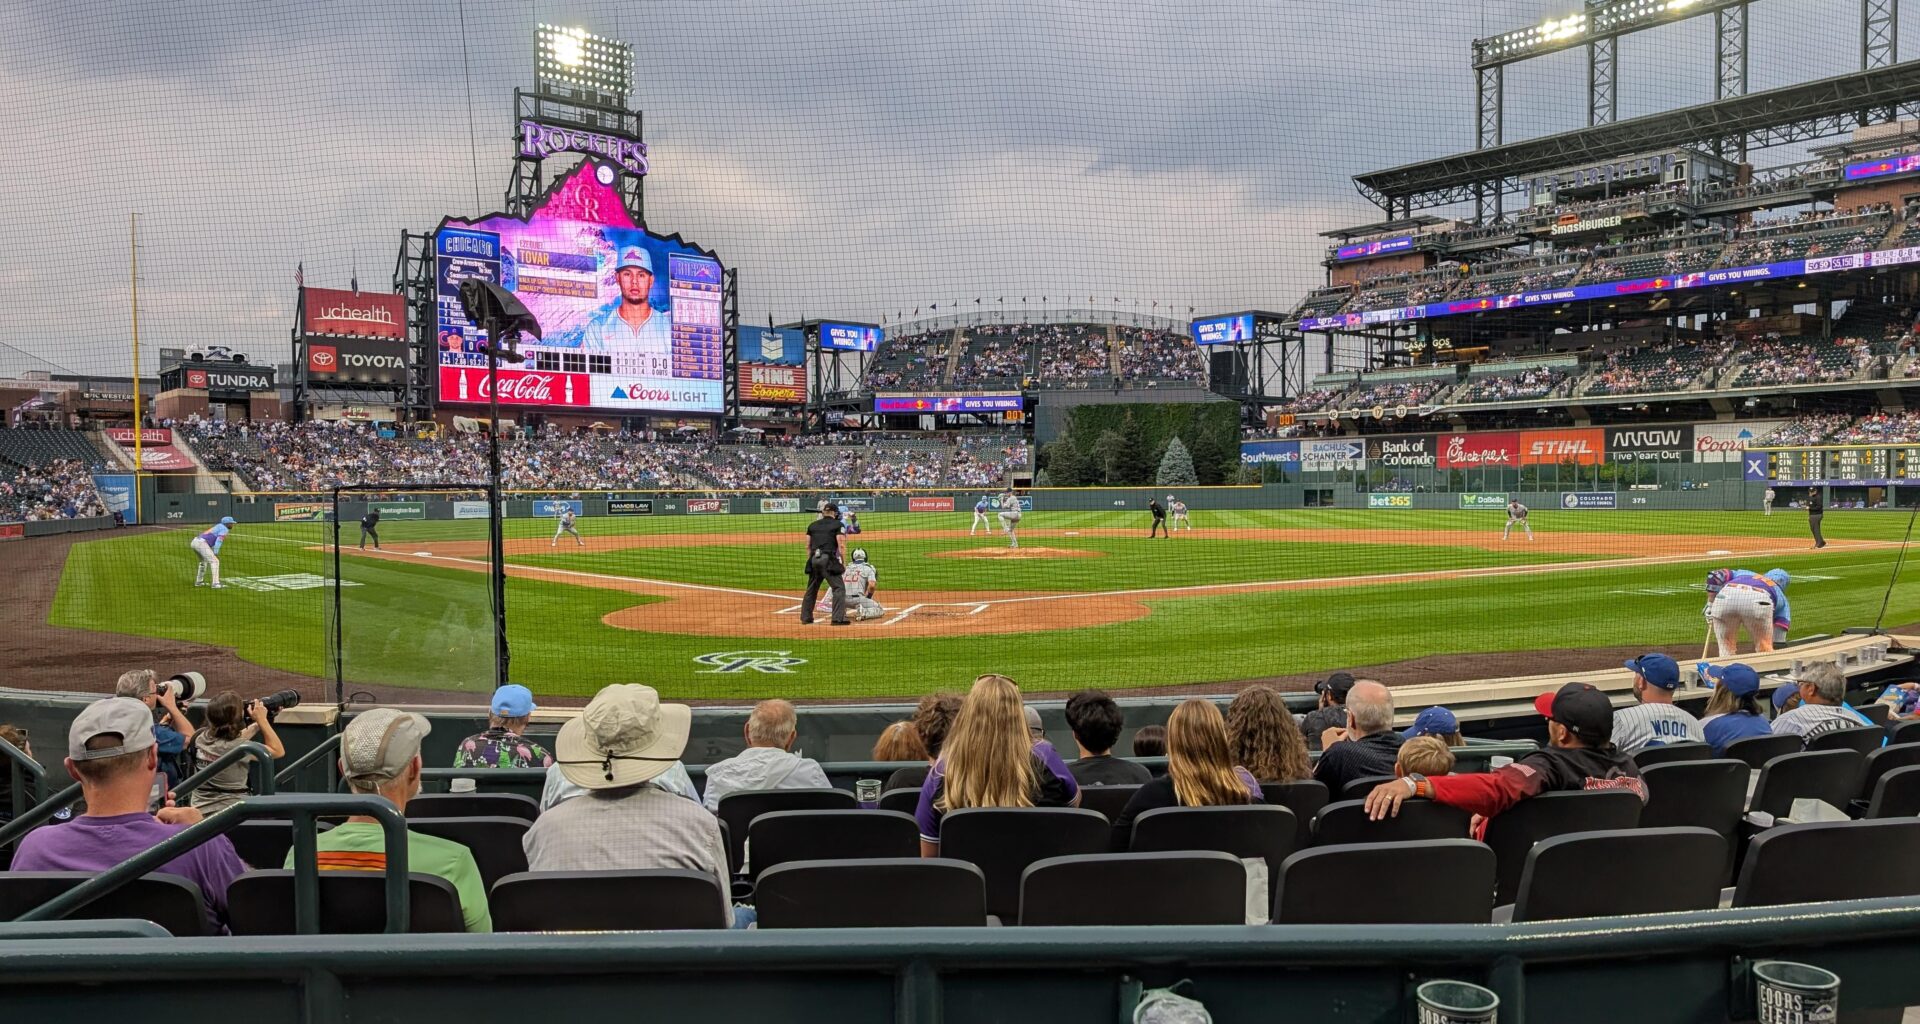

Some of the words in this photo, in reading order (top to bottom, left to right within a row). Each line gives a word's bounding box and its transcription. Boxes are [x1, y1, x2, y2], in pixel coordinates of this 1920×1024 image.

[521, 120, 649, 174] ROCKIES
[446, 237, 493, 257] CHICAGO
[519, 250, 550, 266] TOVAR
[1708, 273, 1727, 282] GIVES
[1728, 271, 1742, 280] YOU
[1525, 294, 1539, 302] GIVES
[1540, 293, 1552, 301] YOU
[321, 302, 392, 323] uchealth
[830, 328, 846, 337] GIVES
[847, 330, 858, 338] YOU
[1199, 323, 1214, 333] GIVES
[1214, 322, 1227, 331] YOU
[468, 342, 474, 351] 0
[342, 353, 405, 369] TOYOTA
[207, 374, 269, 388] TUNDRA
[752, 367, 795, 386] KING
[629, 383, 671, 401] Coors
[671, 391, 708, 403] LIGHT
[751, 383, 797, 399] Soopers
[827, 411, 844, 420] PLATTE
[1375, 408, 1381, 416] 17
[1382, 441, 1410, 453] Bank
[1412, 438, 1425, 452] of
[1613, 430, 1681, 447] ARROW
[1697, 435, 1744, 452] Coors
[1312, 442, 1347, 452] BACHUS
[1529, 440, 1593, 455] STIHL
[1241, 451, 1291, 463] Southwest
[1303, 451, 1347, 461] SCHANKER
[1383, 451, 1435, 466] Colorado
[1661, 450, 1680, 460] Out
[688, 504, 706, 513] TREE
[706, 501, 720, 510] TOP
[1370, 495, 1410, 506] bet365
[167, 511, 184, 519] 347
[280, 506, 311, 515] MIGHTY
[1651, 718, 1687, 739] WOOD
[1760, 984, 1802, 1011] COORS
[1761, 1002, 1803, 1024] FIELD
